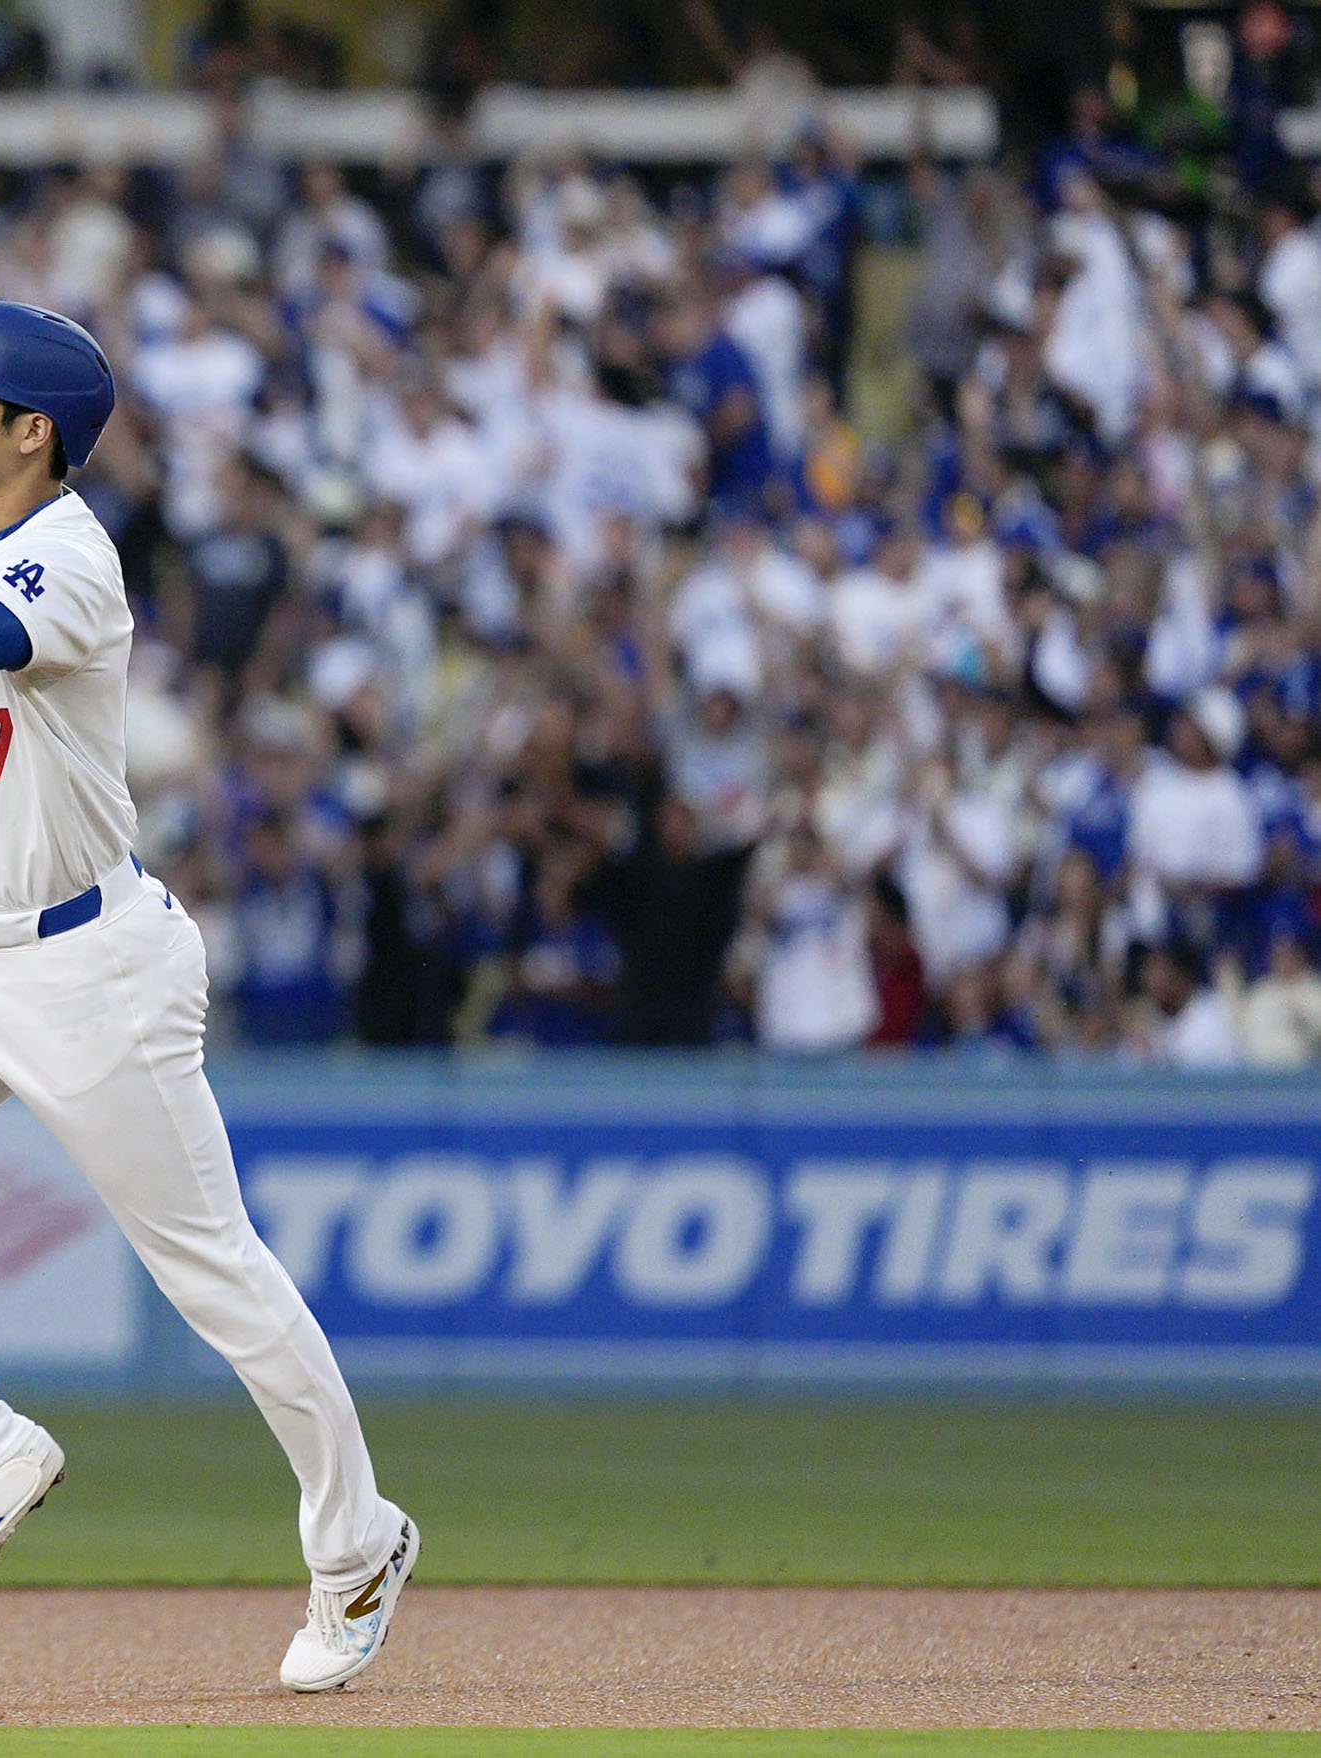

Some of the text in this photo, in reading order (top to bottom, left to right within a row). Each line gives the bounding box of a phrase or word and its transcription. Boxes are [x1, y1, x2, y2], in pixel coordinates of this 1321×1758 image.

[2, 559, 45, 603] LA
[249, 1153, 1318, 1307] TOYO TIRES
